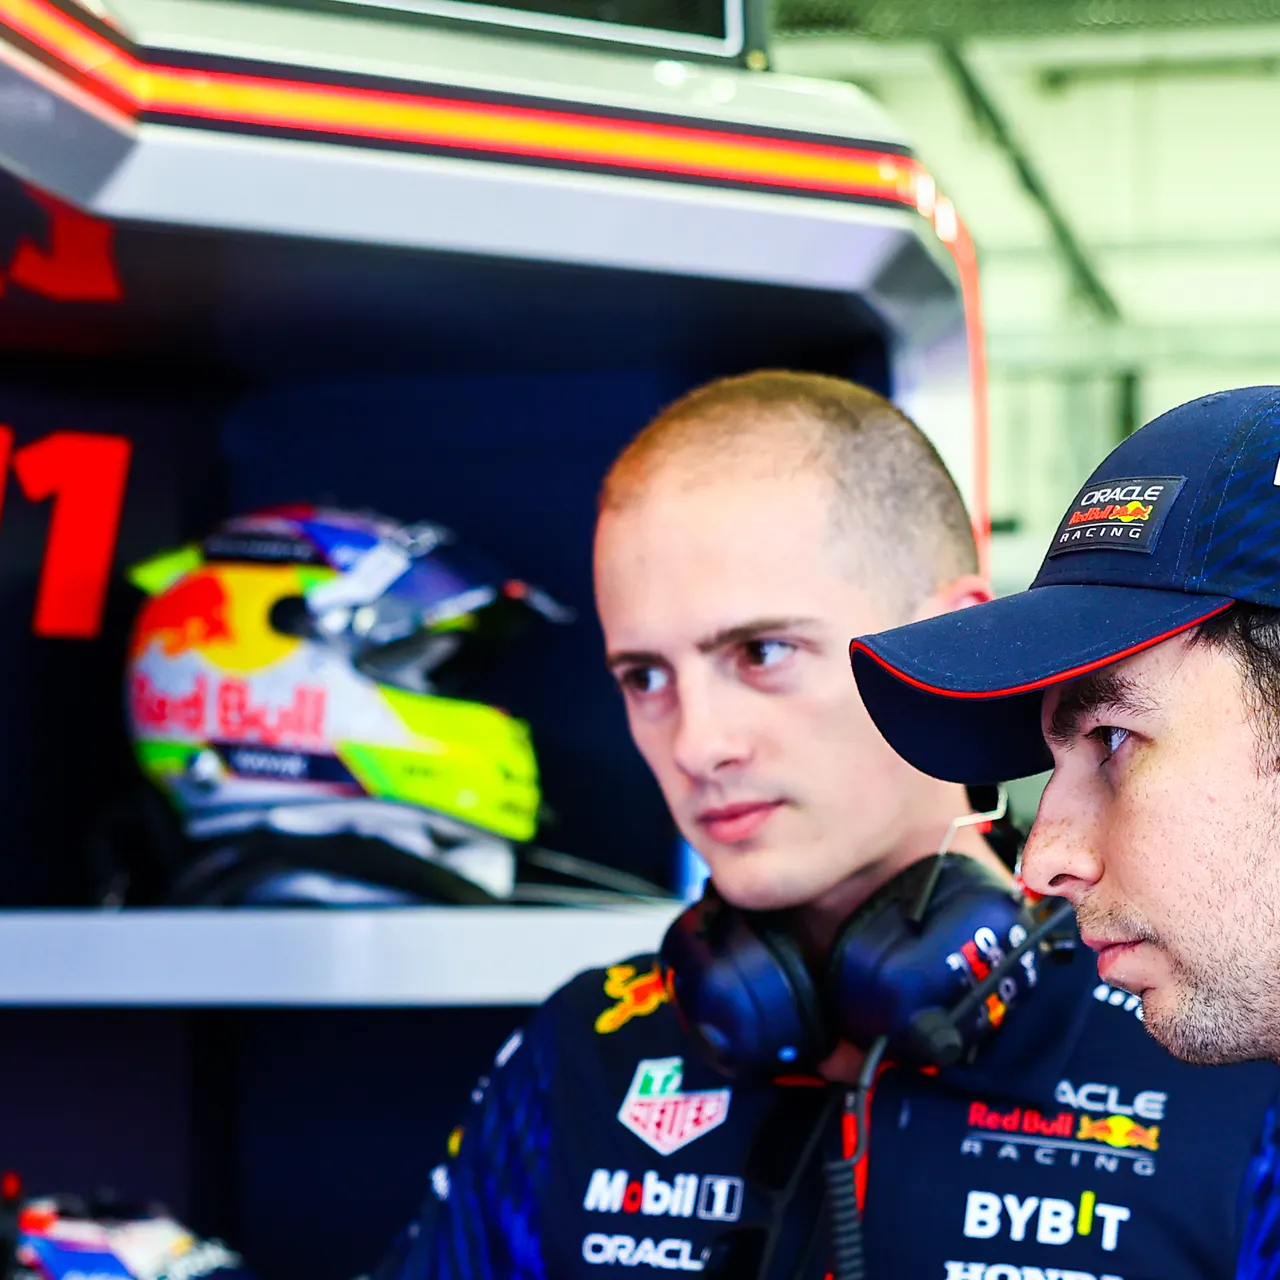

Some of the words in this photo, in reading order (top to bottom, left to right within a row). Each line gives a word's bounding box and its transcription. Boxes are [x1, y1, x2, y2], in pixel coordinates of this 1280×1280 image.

[1081, 485, 1164, 506] ORACLE
[1060, 527, 1141, 542] RACING
[1055, 1079, 1168, 1121] ACLE
[960, 1137, 1157, 1177] RACING
[582, 1168, 699, 1219] Mobil
[963, 1189, 1131, 1251] BYBIT
[581, 1233, 710, 1272] ORACL
